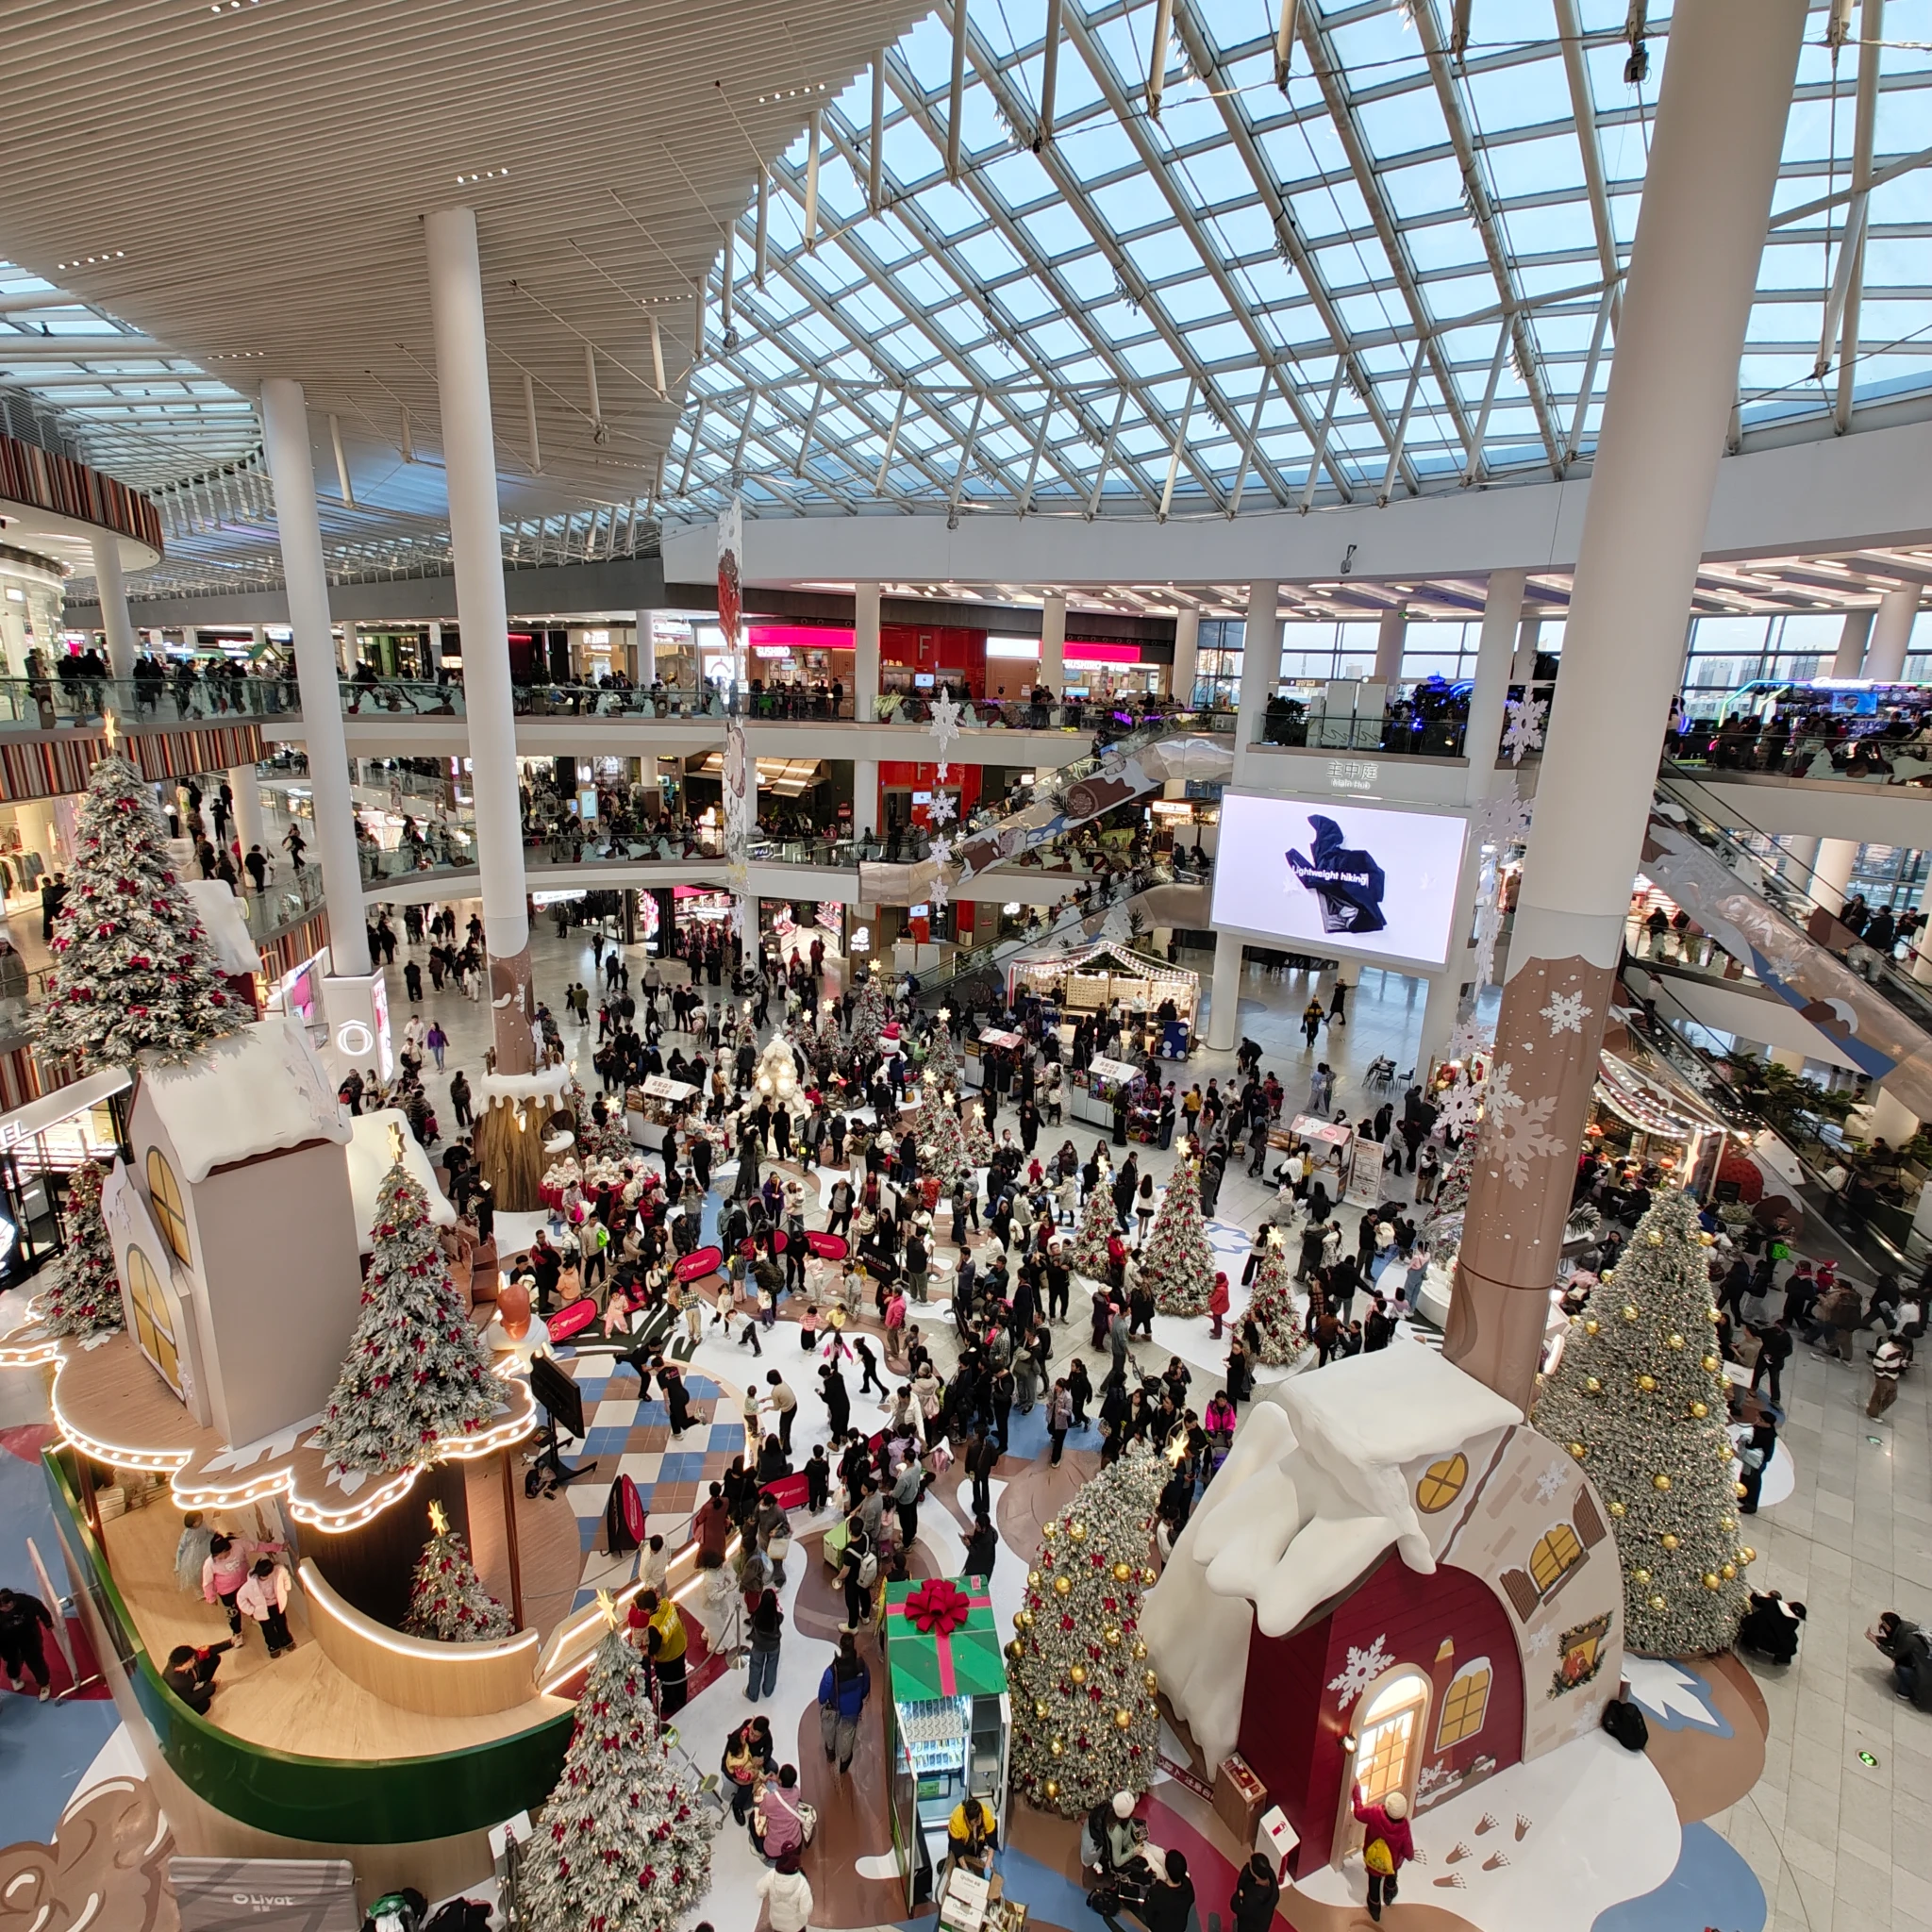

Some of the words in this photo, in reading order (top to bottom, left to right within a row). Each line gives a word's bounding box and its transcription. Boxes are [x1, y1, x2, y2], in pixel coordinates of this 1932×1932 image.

[1326, 760, 1378, 781] 主中庭
[1291, 865, 1340, 881] Lightweight
[1341, 872, 1367, 886] hiking
[250, 1894, 295, 1906] Livat
